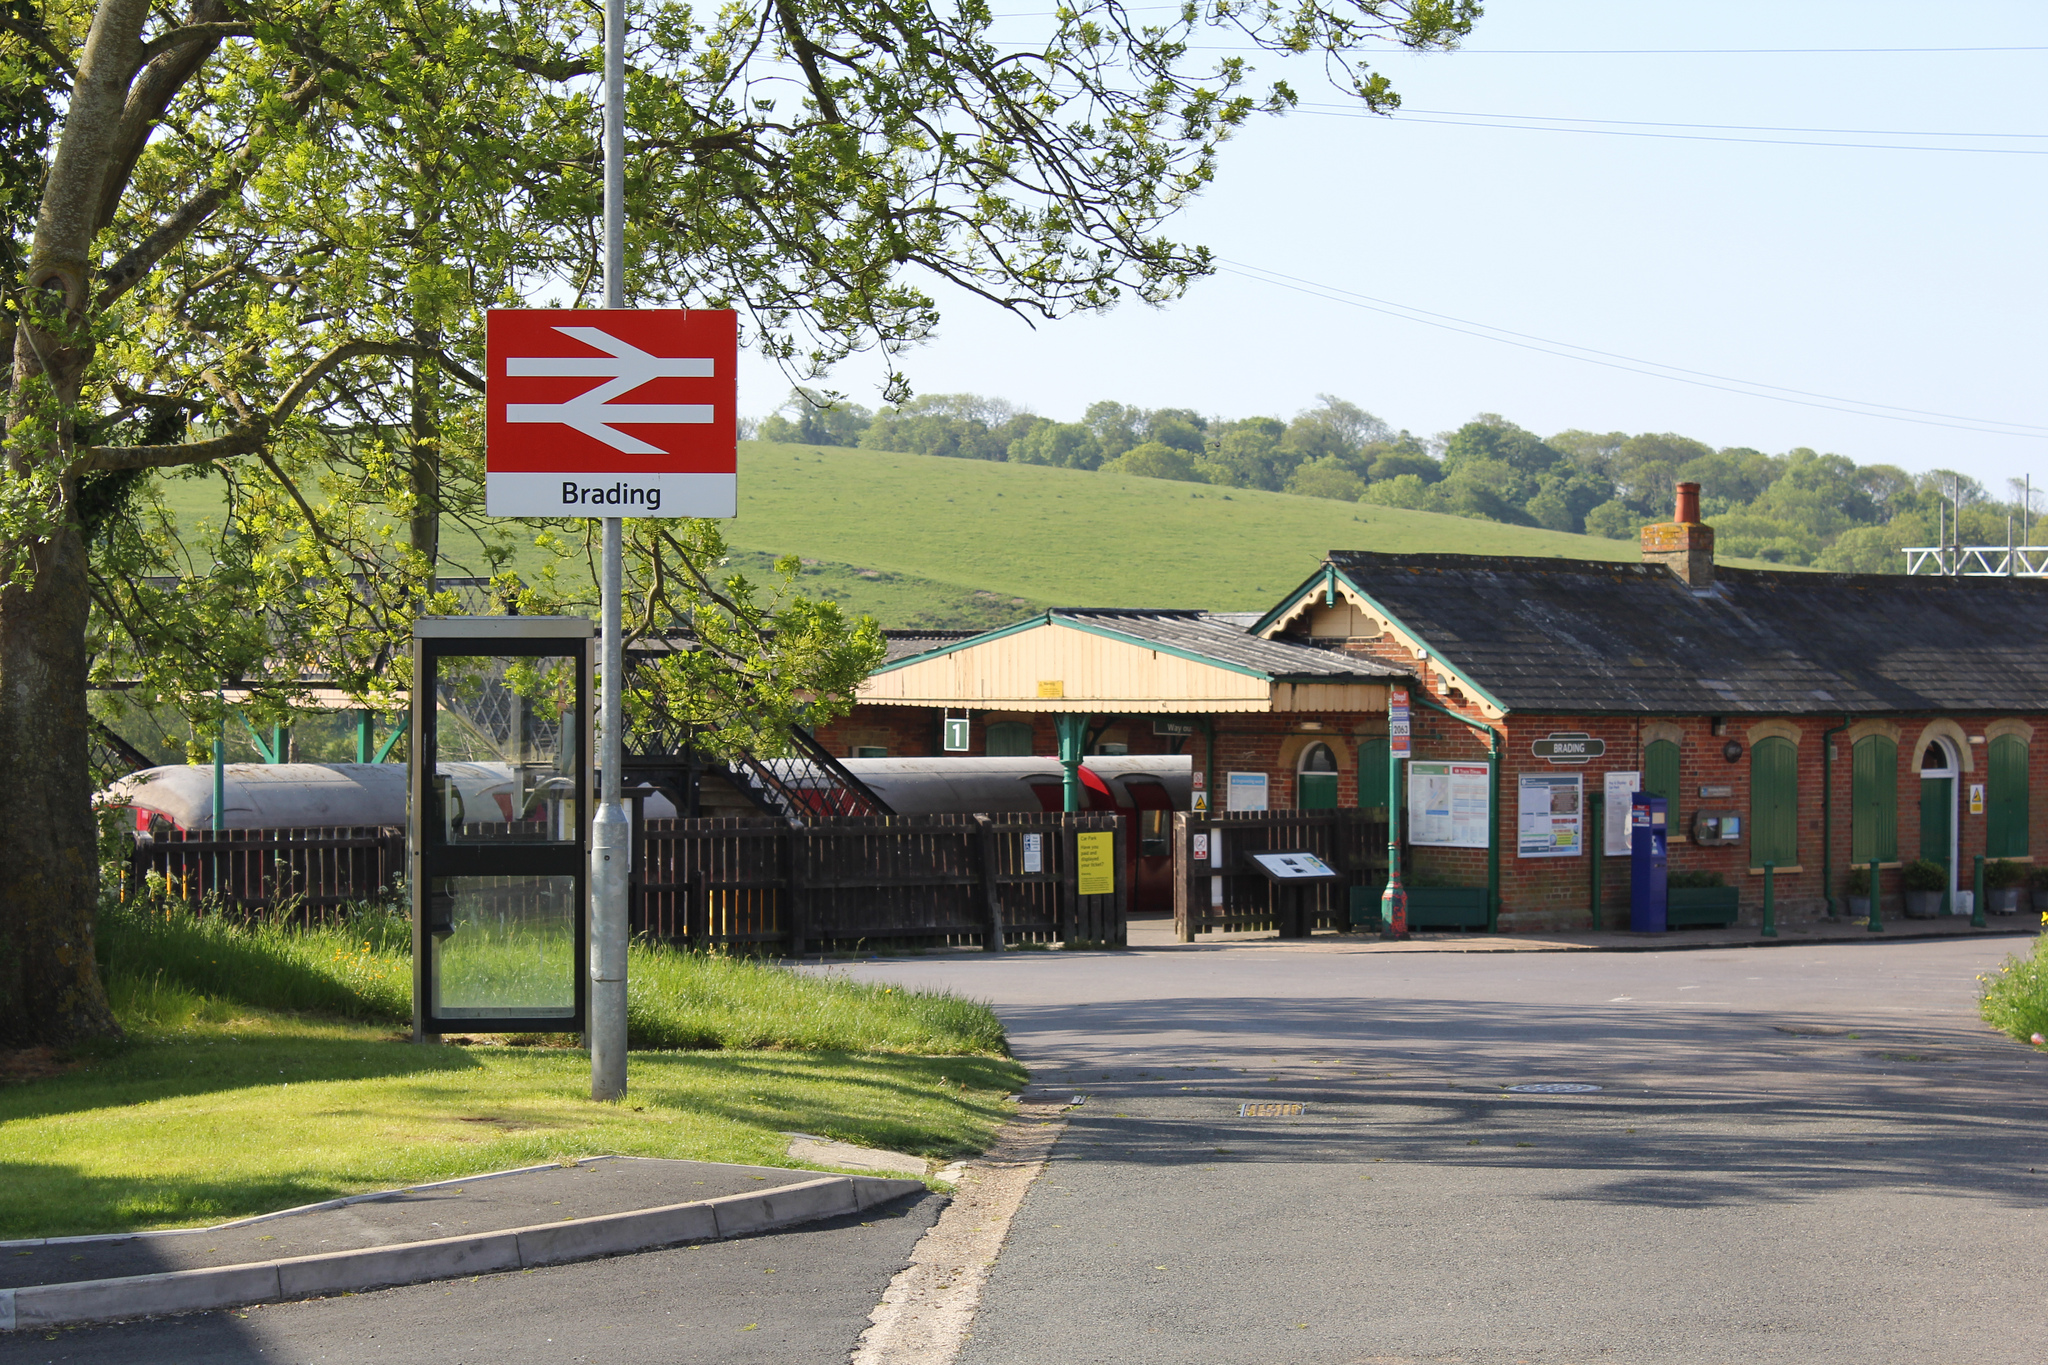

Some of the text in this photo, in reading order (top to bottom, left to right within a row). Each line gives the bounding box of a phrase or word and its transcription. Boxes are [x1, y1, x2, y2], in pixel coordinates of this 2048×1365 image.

[562, 481, 661, 510] Brading
[1167, 723, 1182, 734] Way
[1394, 725, 1408, 734] 2063
[952, 723, 961, 747] 1
[1553, 743, 1585, 753] BRADING
